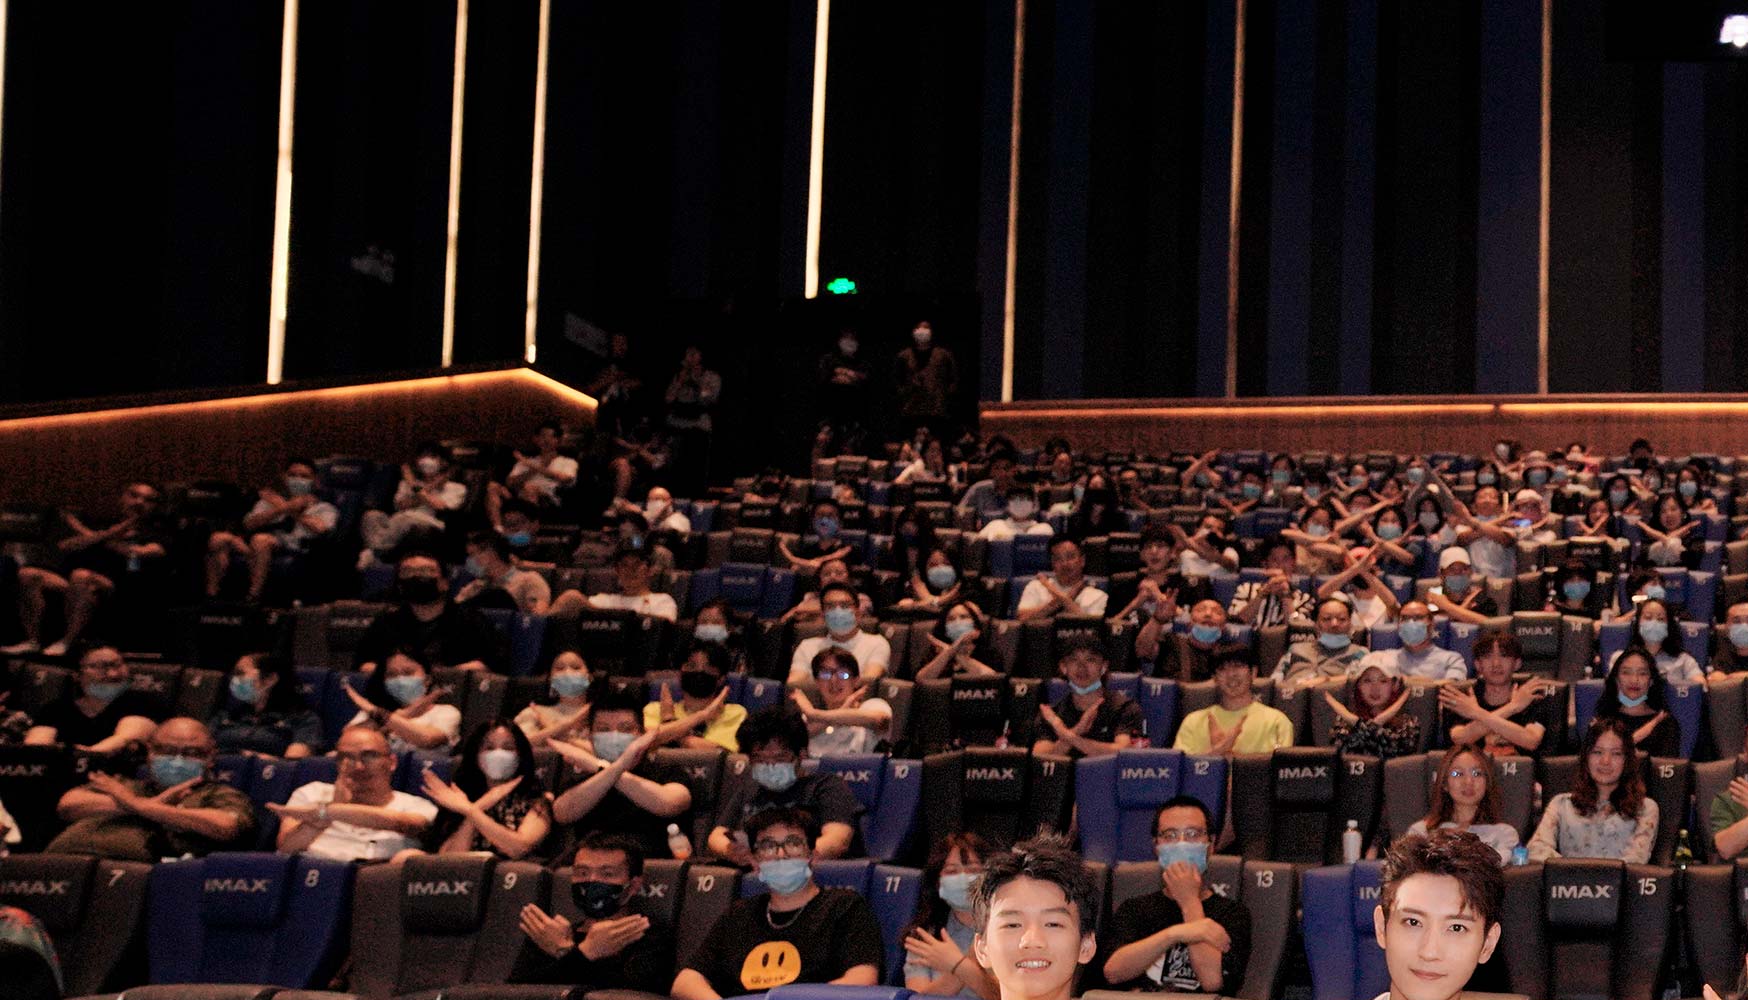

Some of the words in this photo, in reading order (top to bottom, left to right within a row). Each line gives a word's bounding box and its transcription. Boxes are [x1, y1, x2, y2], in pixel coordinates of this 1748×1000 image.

[966, 767, 1017, 781] IMAX
[1121, 767, 1171, 780] IMAX
[1278, 766, 1328, 780] IMAX
[1349, 761, 1365, 776] 13
[1501, 762, 1518, 776] 14
[1658, 764, 1675, 779] 15
[108, 868, 126, 888] 7
[203, 877, 270, 895] IMAX
[304, 869, 320, 888] 8
[503, 871, 519, 891] 9
[696, 874, 715, 893] 10
[884, 875, 902, 894] 11
[1255, 870, 1274, 888] 13
[1637, 877, 1658, 896] 15
[408, 879, 473, 897] IMAX
[1551, 884, 1613, 901] IMAX
